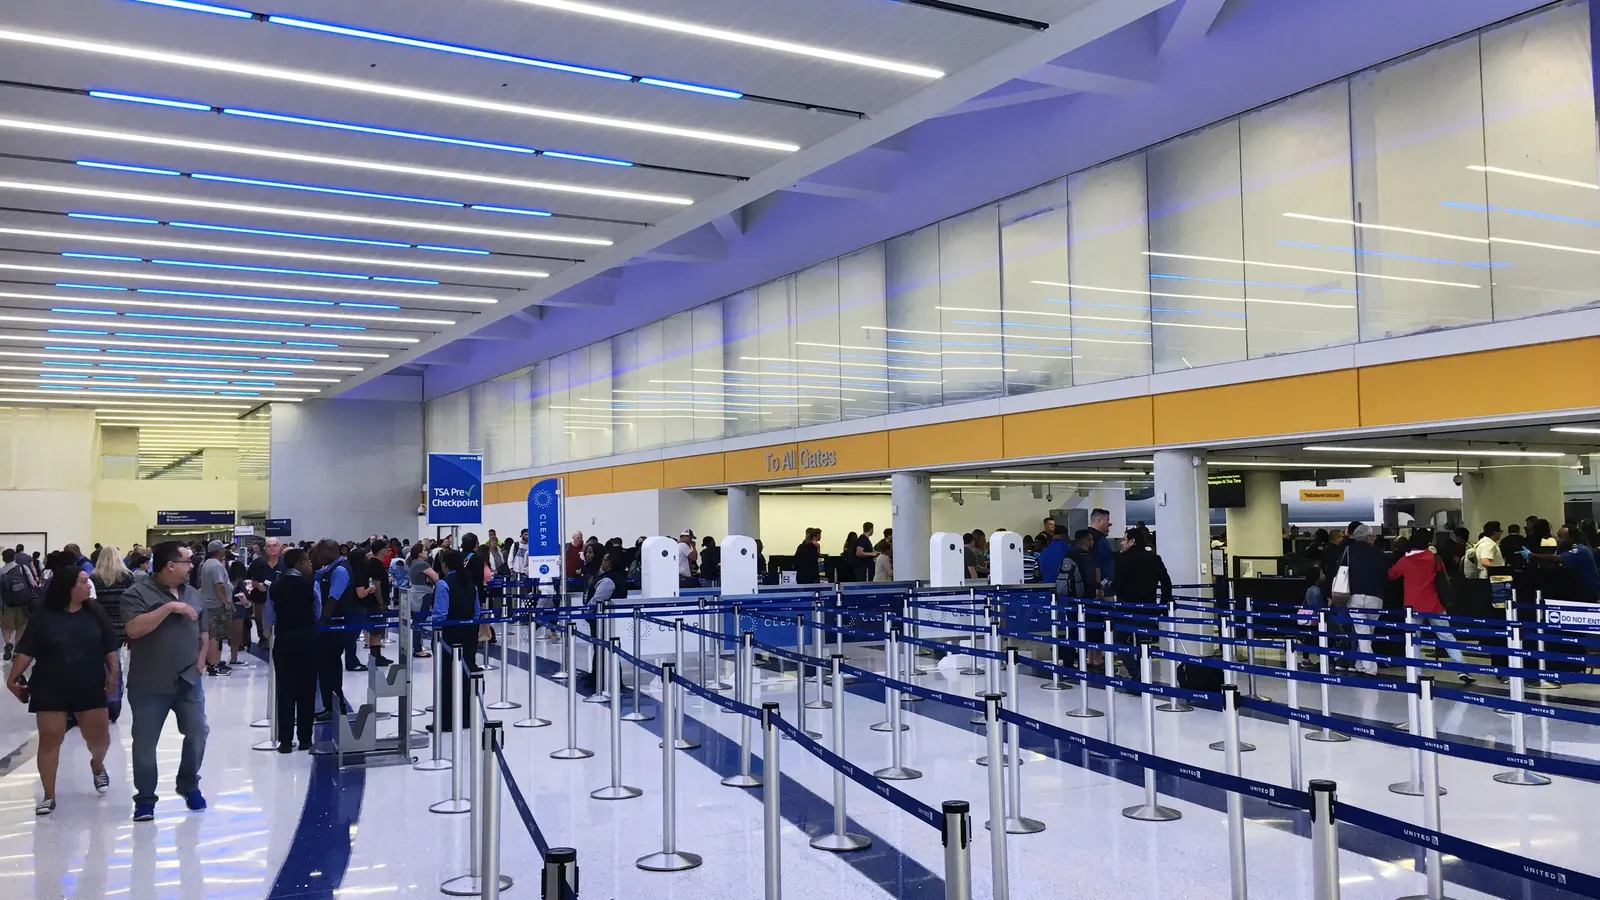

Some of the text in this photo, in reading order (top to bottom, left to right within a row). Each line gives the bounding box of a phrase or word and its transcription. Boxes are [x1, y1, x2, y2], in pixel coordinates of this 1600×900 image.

[764, 448, 836, 472] To All Gates
[434, 488, 465, 497] TSA Pre
[432, 498, 479, 508] Checkpoint
[1425, 741, 1443, 749] UNITED
[1507, 756, 1528, 764] UNITED
[1179, 768, 1196, 776] UNITED
[1250, 785, 1268, 794] UNITED
[1404, 829, 1430, 842] UNITED
[1523, 865, 1556, 880] UNITED
